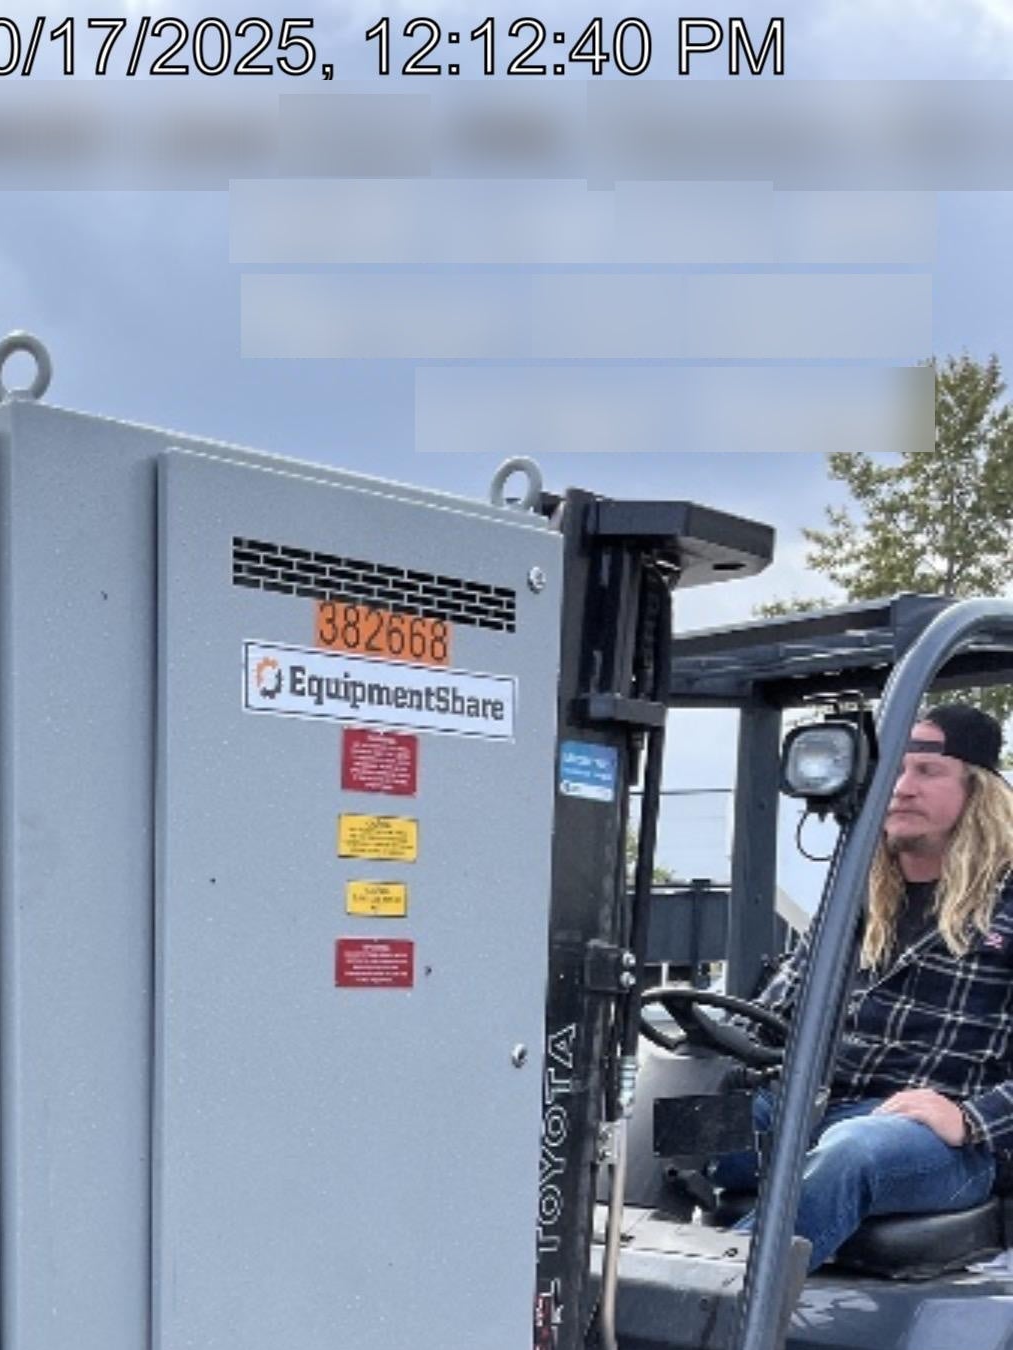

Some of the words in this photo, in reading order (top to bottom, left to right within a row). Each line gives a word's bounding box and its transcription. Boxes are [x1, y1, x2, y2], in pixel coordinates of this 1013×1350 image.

[318, 601, 449, 662] 382668
[289, 665, 505, 721] EquipmentShare
[536, 1022, 577, 1263] TOYOTA
